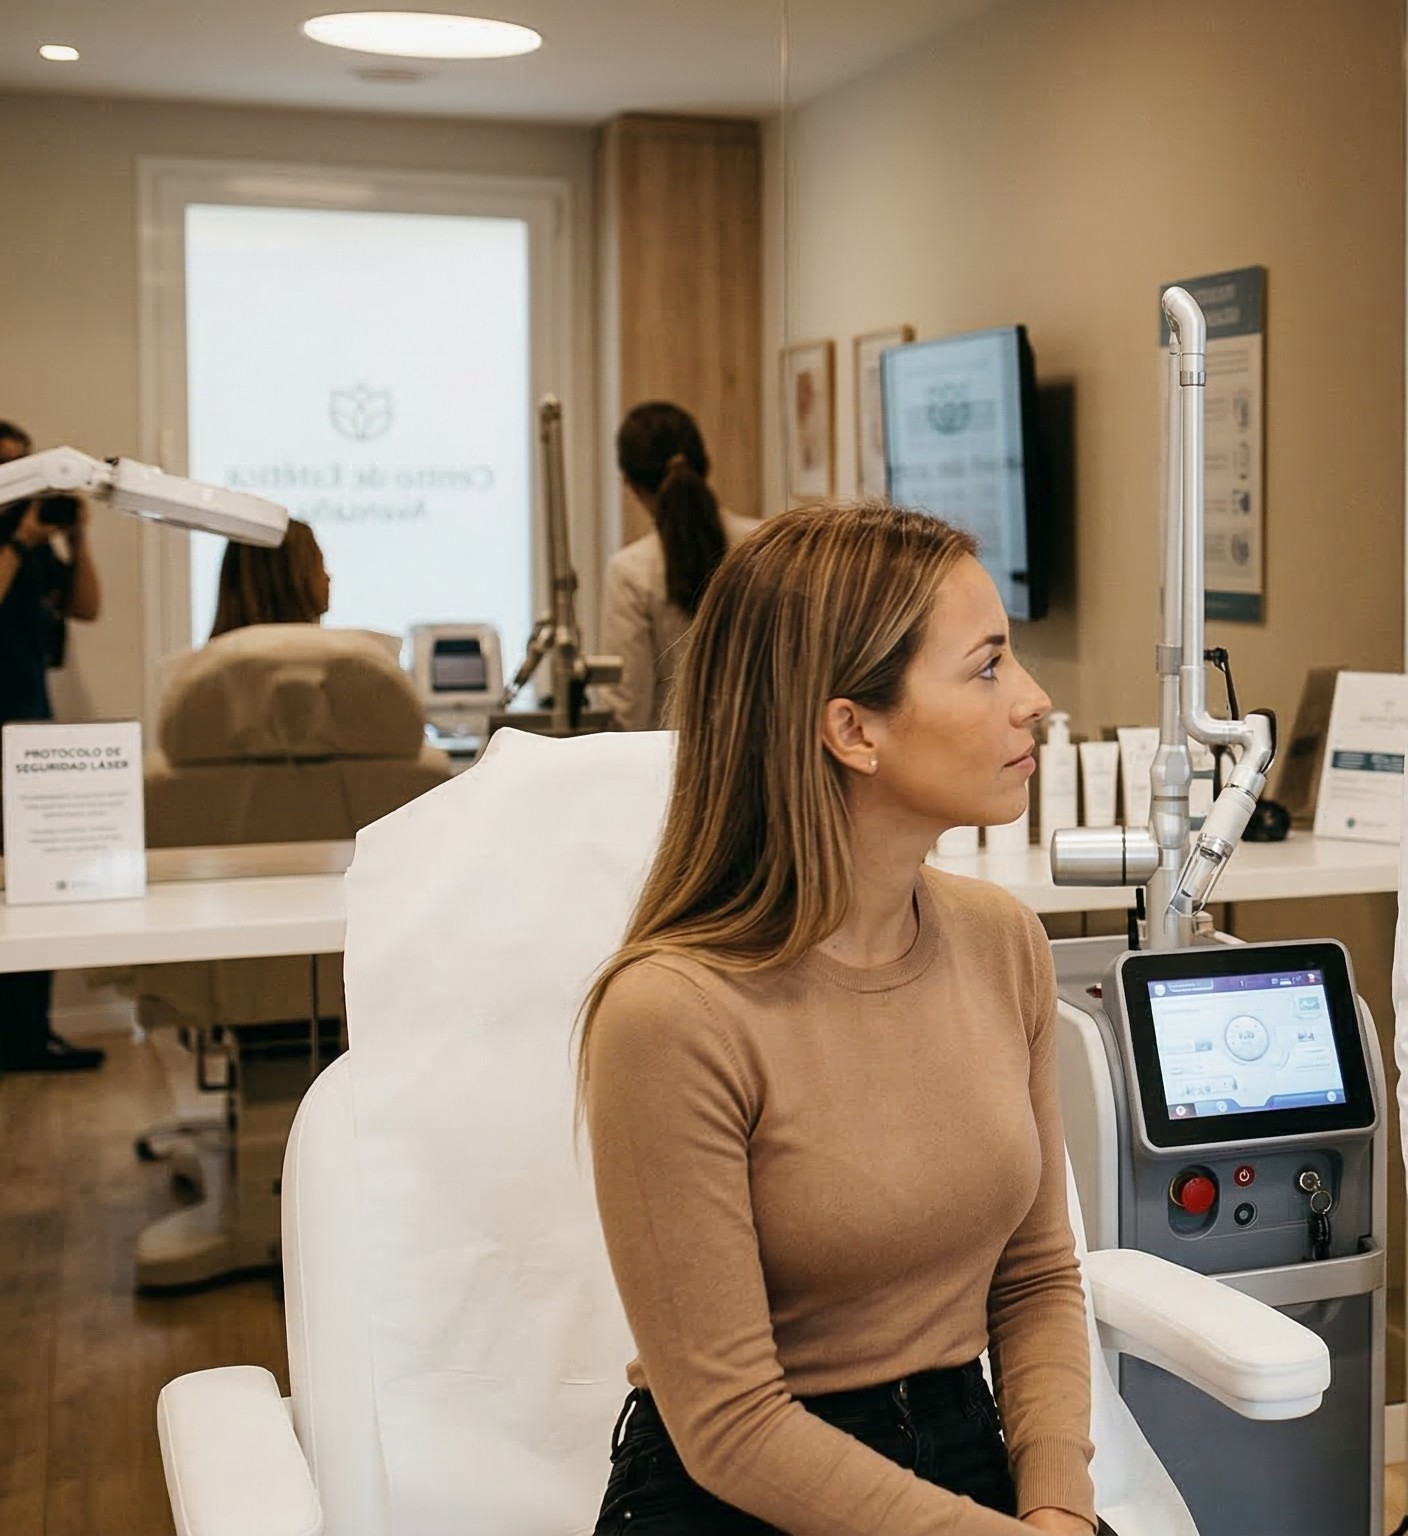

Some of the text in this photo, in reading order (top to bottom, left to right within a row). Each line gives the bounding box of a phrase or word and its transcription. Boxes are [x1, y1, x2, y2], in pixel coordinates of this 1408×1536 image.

[24, 747, 121, 759] PROTOCOLO DE
[15, 760, 129, 774] SEGURIDAD LÁSER
